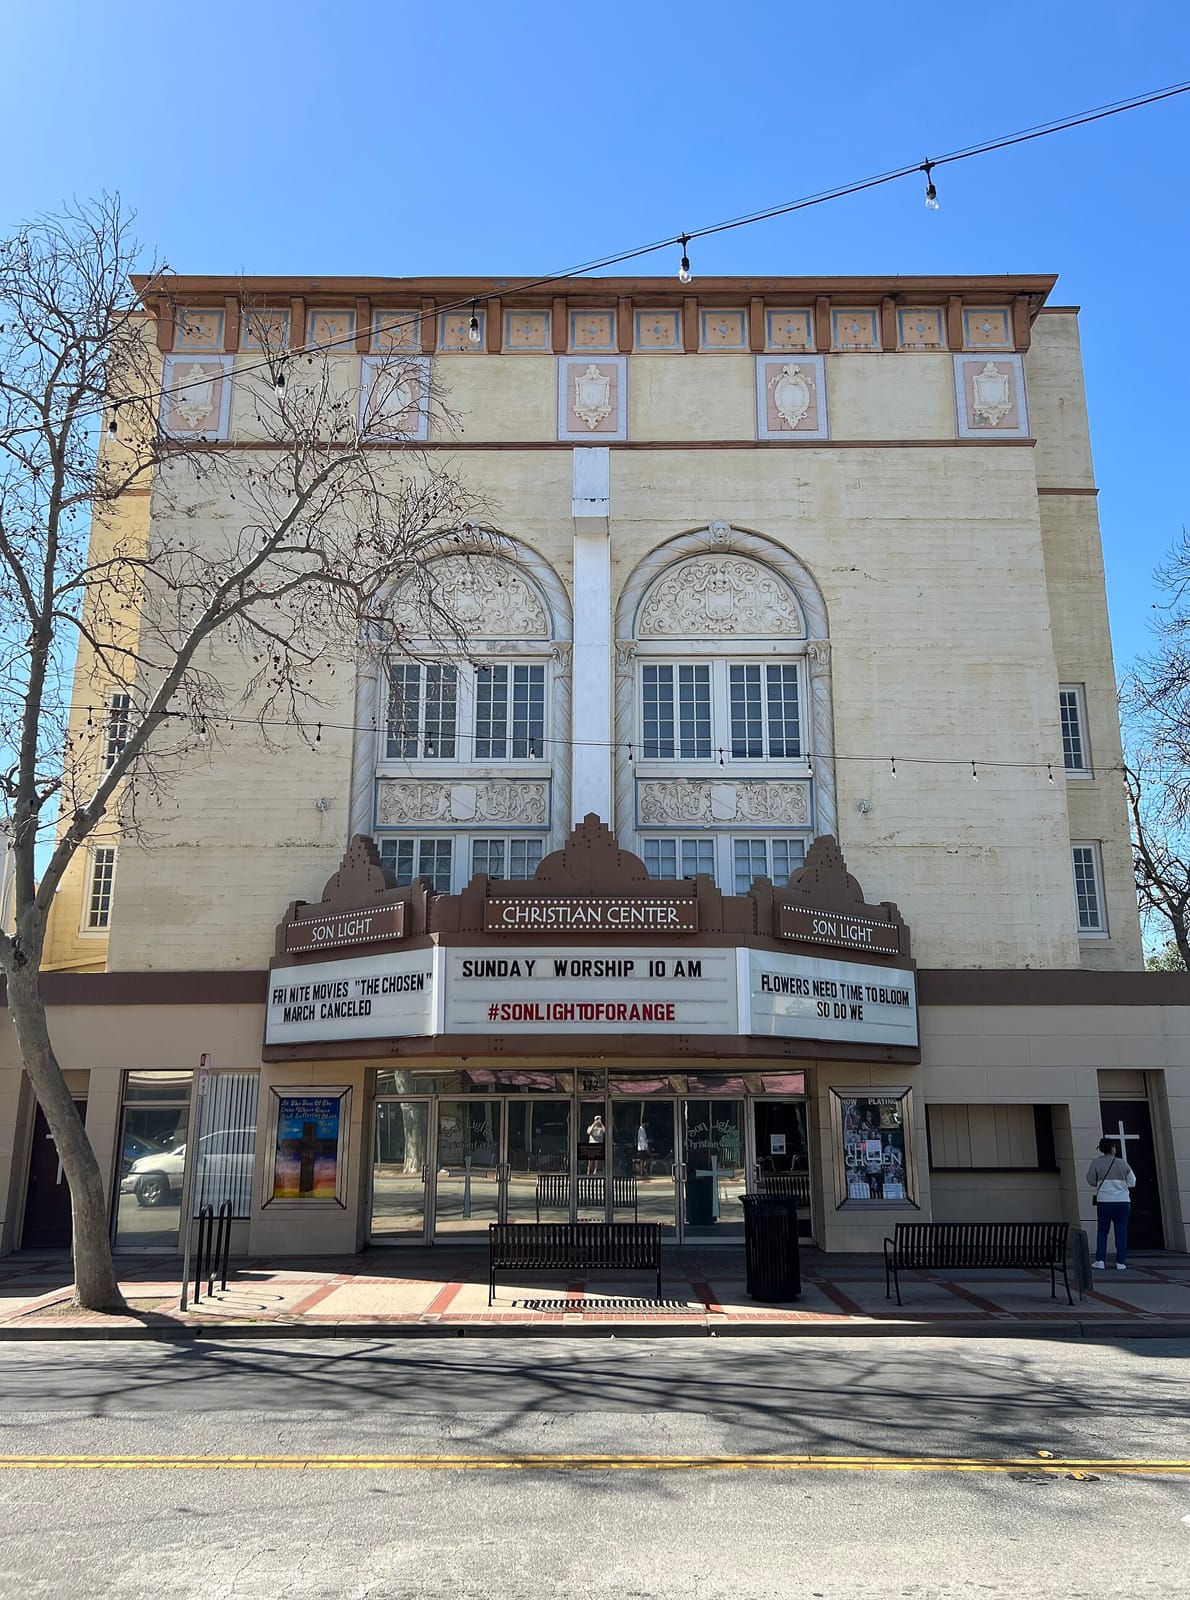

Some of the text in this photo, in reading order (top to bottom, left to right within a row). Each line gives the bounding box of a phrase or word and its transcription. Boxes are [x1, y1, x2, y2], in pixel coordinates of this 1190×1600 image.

[502, 906, 680, 924] CHRISTIAN CENTER
[311, 918, 373, 943] SON LIGHT
[812, 919, 873, 943] SON LIGHT
[462, 959, 536, 978] SUNDAY
[553, 959, 635, 978] WORSHIP
[673, 959, 702, 978] AM
[272, 988, 288, 1005] FRI
[289, 984, 311, 1003] NITE
[312, 981, 349, 1001] MOVIES
[760, 974, 910, 1006] FLOWERS NEED TIME TO BLOOM
[283, 999, 372, 1023] MARCH CANCELED
[487, 1003, 676, 1021] #SONLIGHTOFORANGE
[816, 1001, 864, 1021] SO DO WE
[582, 1079, 600, 1091] 172
[842, 1098, 857, 1106] NOW
